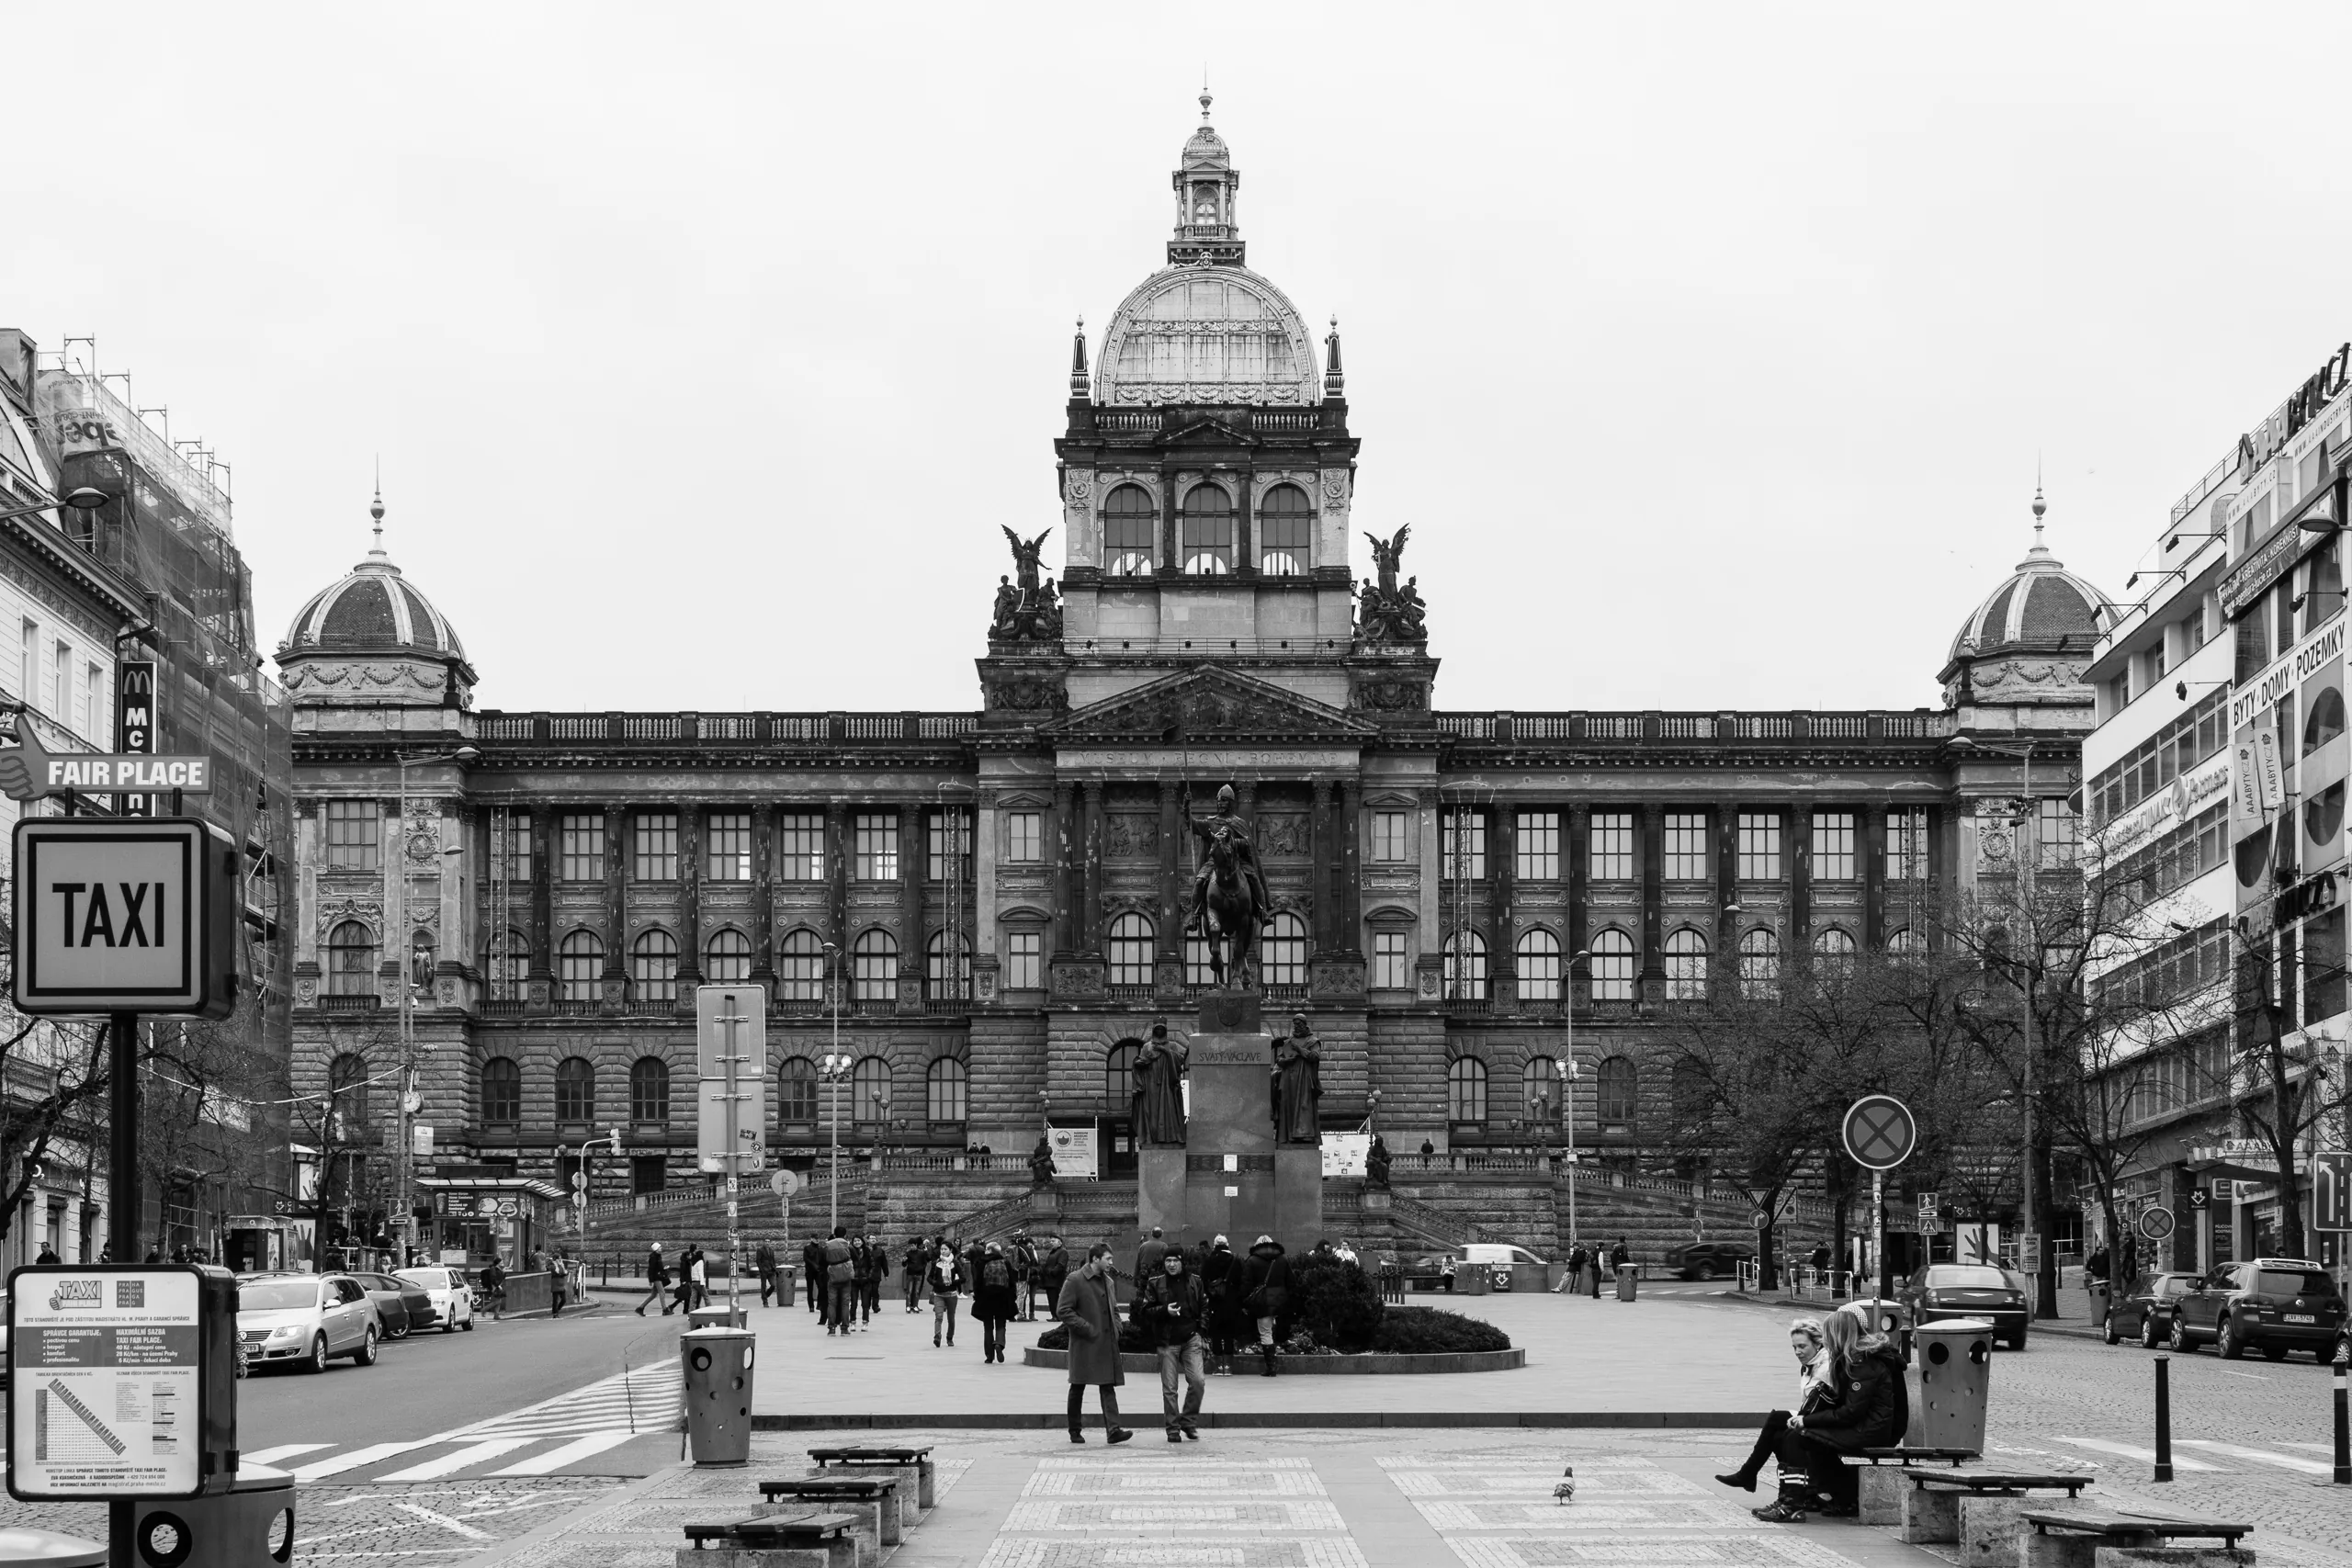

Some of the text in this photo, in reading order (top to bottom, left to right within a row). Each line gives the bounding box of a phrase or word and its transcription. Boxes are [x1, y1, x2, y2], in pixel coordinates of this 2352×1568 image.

[2233, 621, 2346, 727] BYTY DOMY POZEMKY
[49, 761, 203, 786] FAIR PLACE
[52, 883, 164, 948] TAXI
[60, 1280, 102, 1299] TAXI
